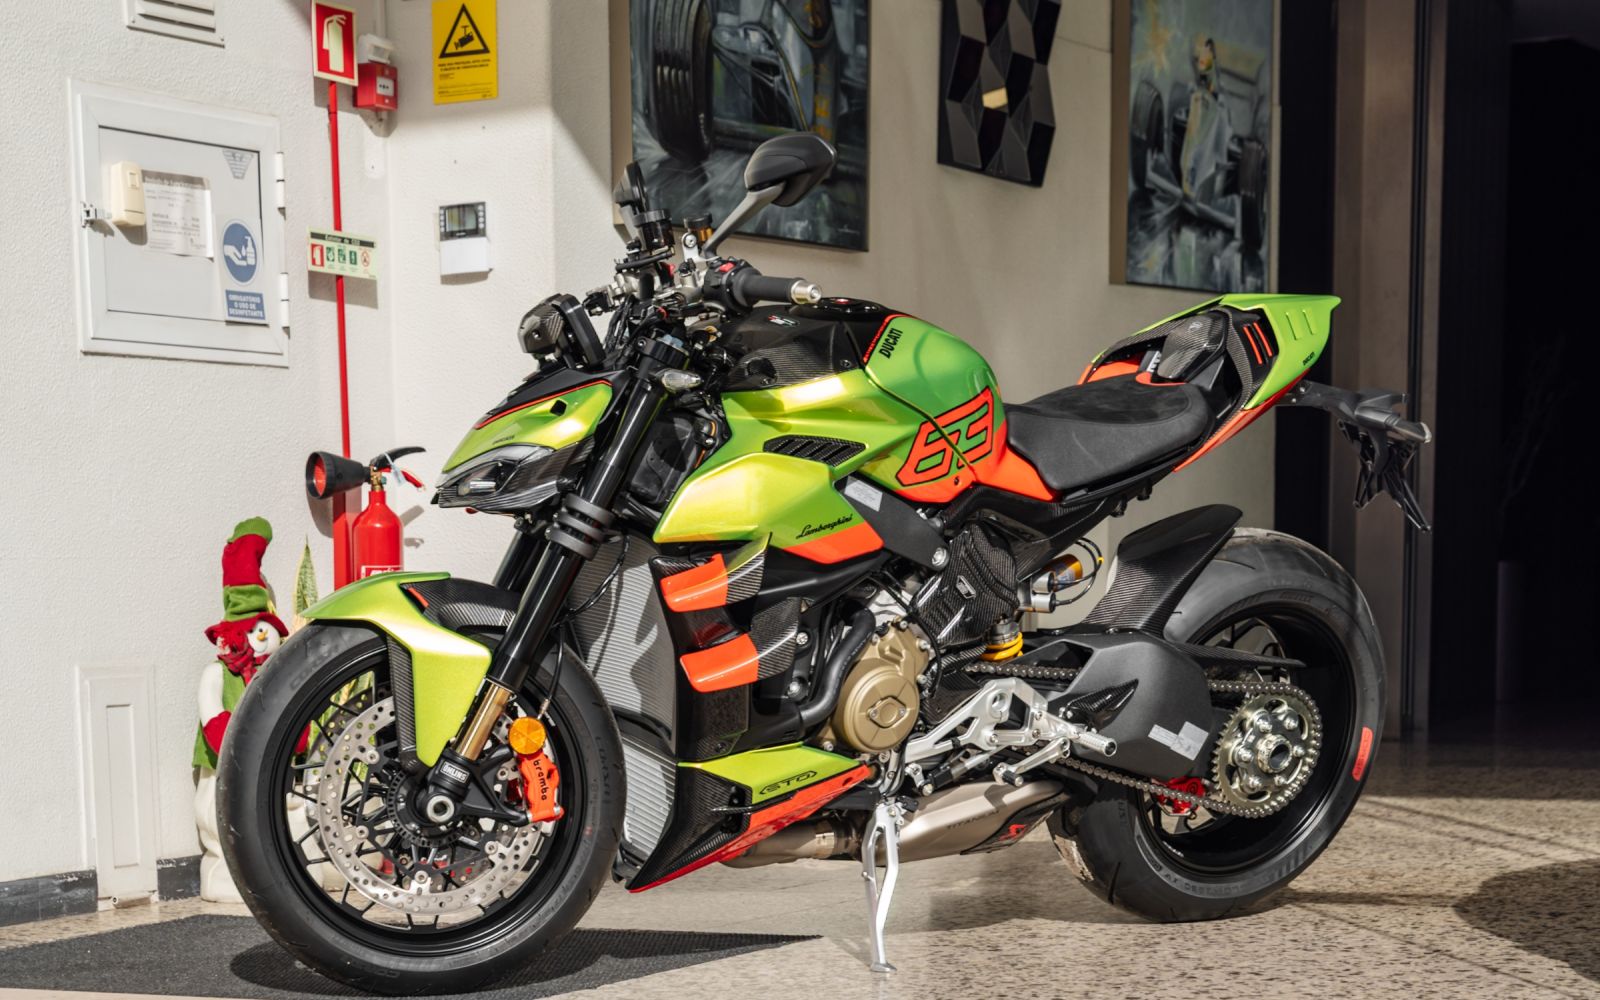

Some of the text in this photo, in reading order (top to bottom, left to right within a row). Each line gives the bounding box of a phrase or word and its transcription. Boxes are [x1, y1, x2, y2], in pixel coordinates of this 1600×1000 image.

[878, 327, 904, 359] DUCATI
[895, 385, 995, 487] 63
[795, 513, 854, 540] Lamborghini
[532, 759, 550, 801] brembo
